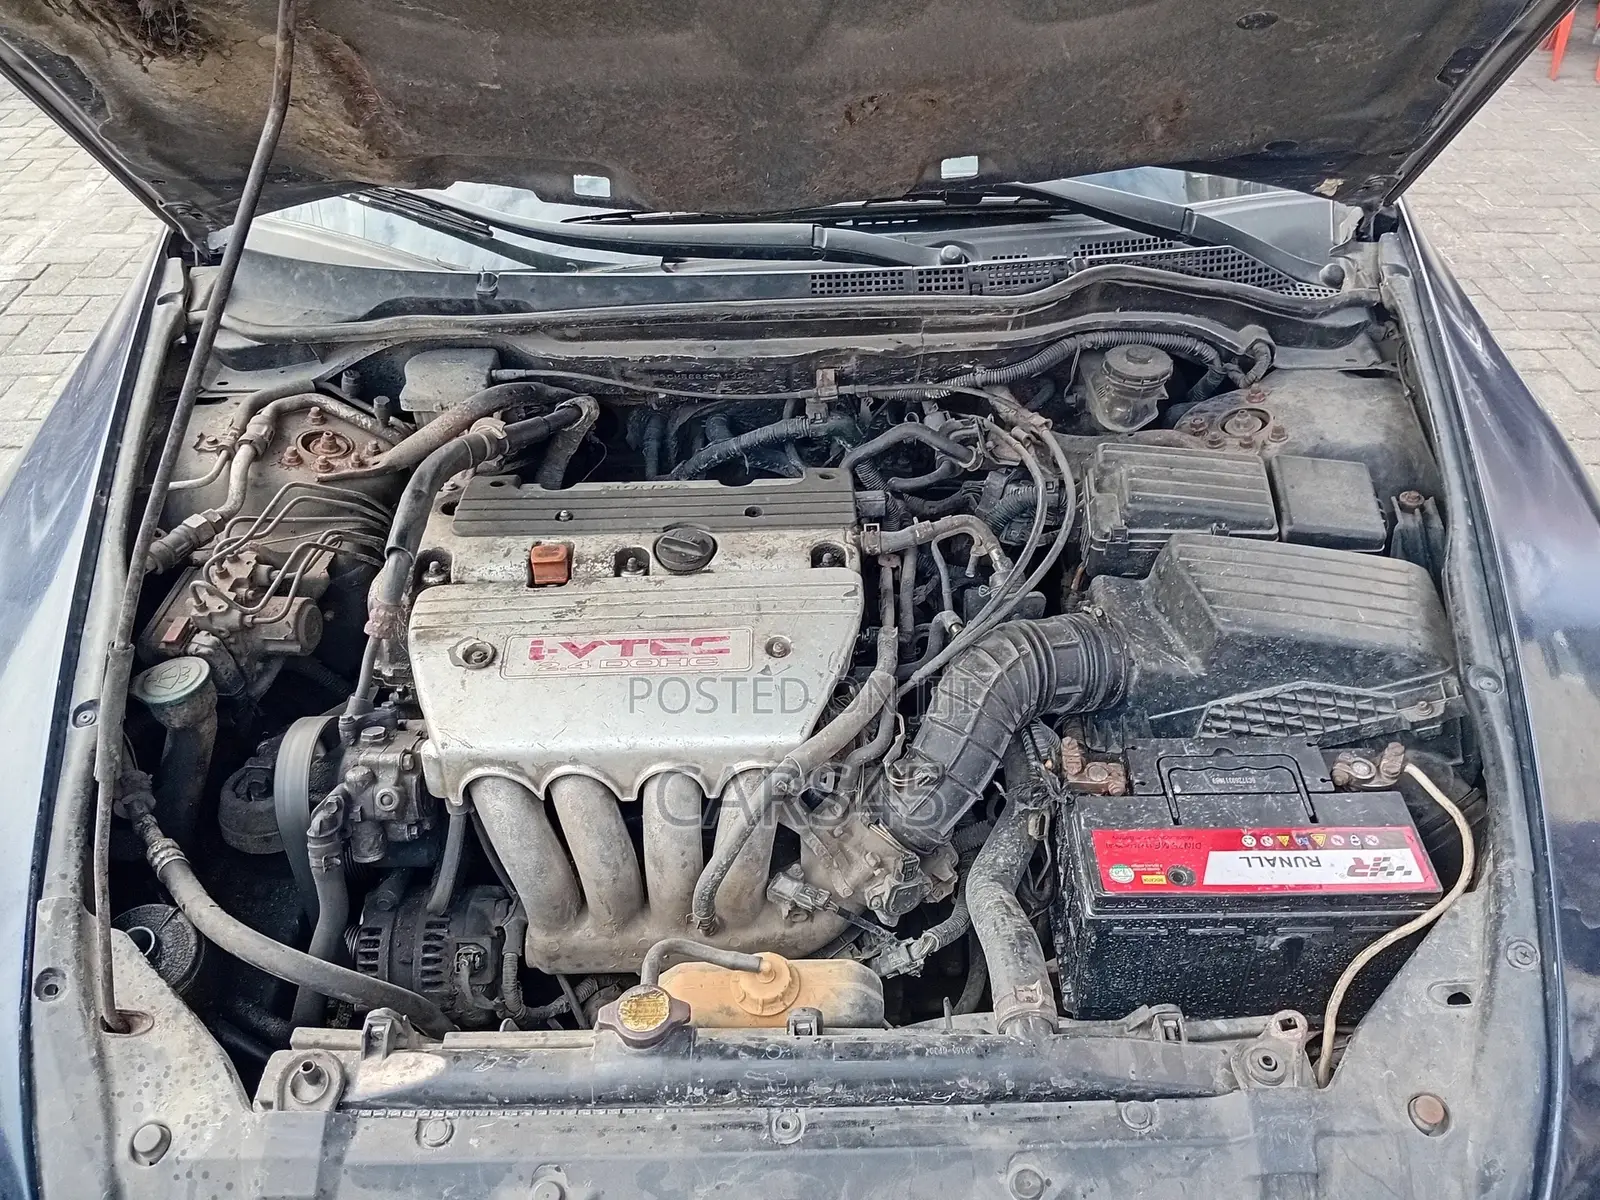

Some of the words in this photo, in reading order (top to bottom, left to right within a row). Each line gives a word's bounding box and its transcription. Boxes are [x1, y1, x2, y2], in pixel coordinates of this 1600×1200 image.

[528, 636, 731, 660] i-VTEC
[536, 659, 591, 672] 2.4
[599, 656, 720, 669] DOHC
[1239, 855, 1321, 869] RUNALL
